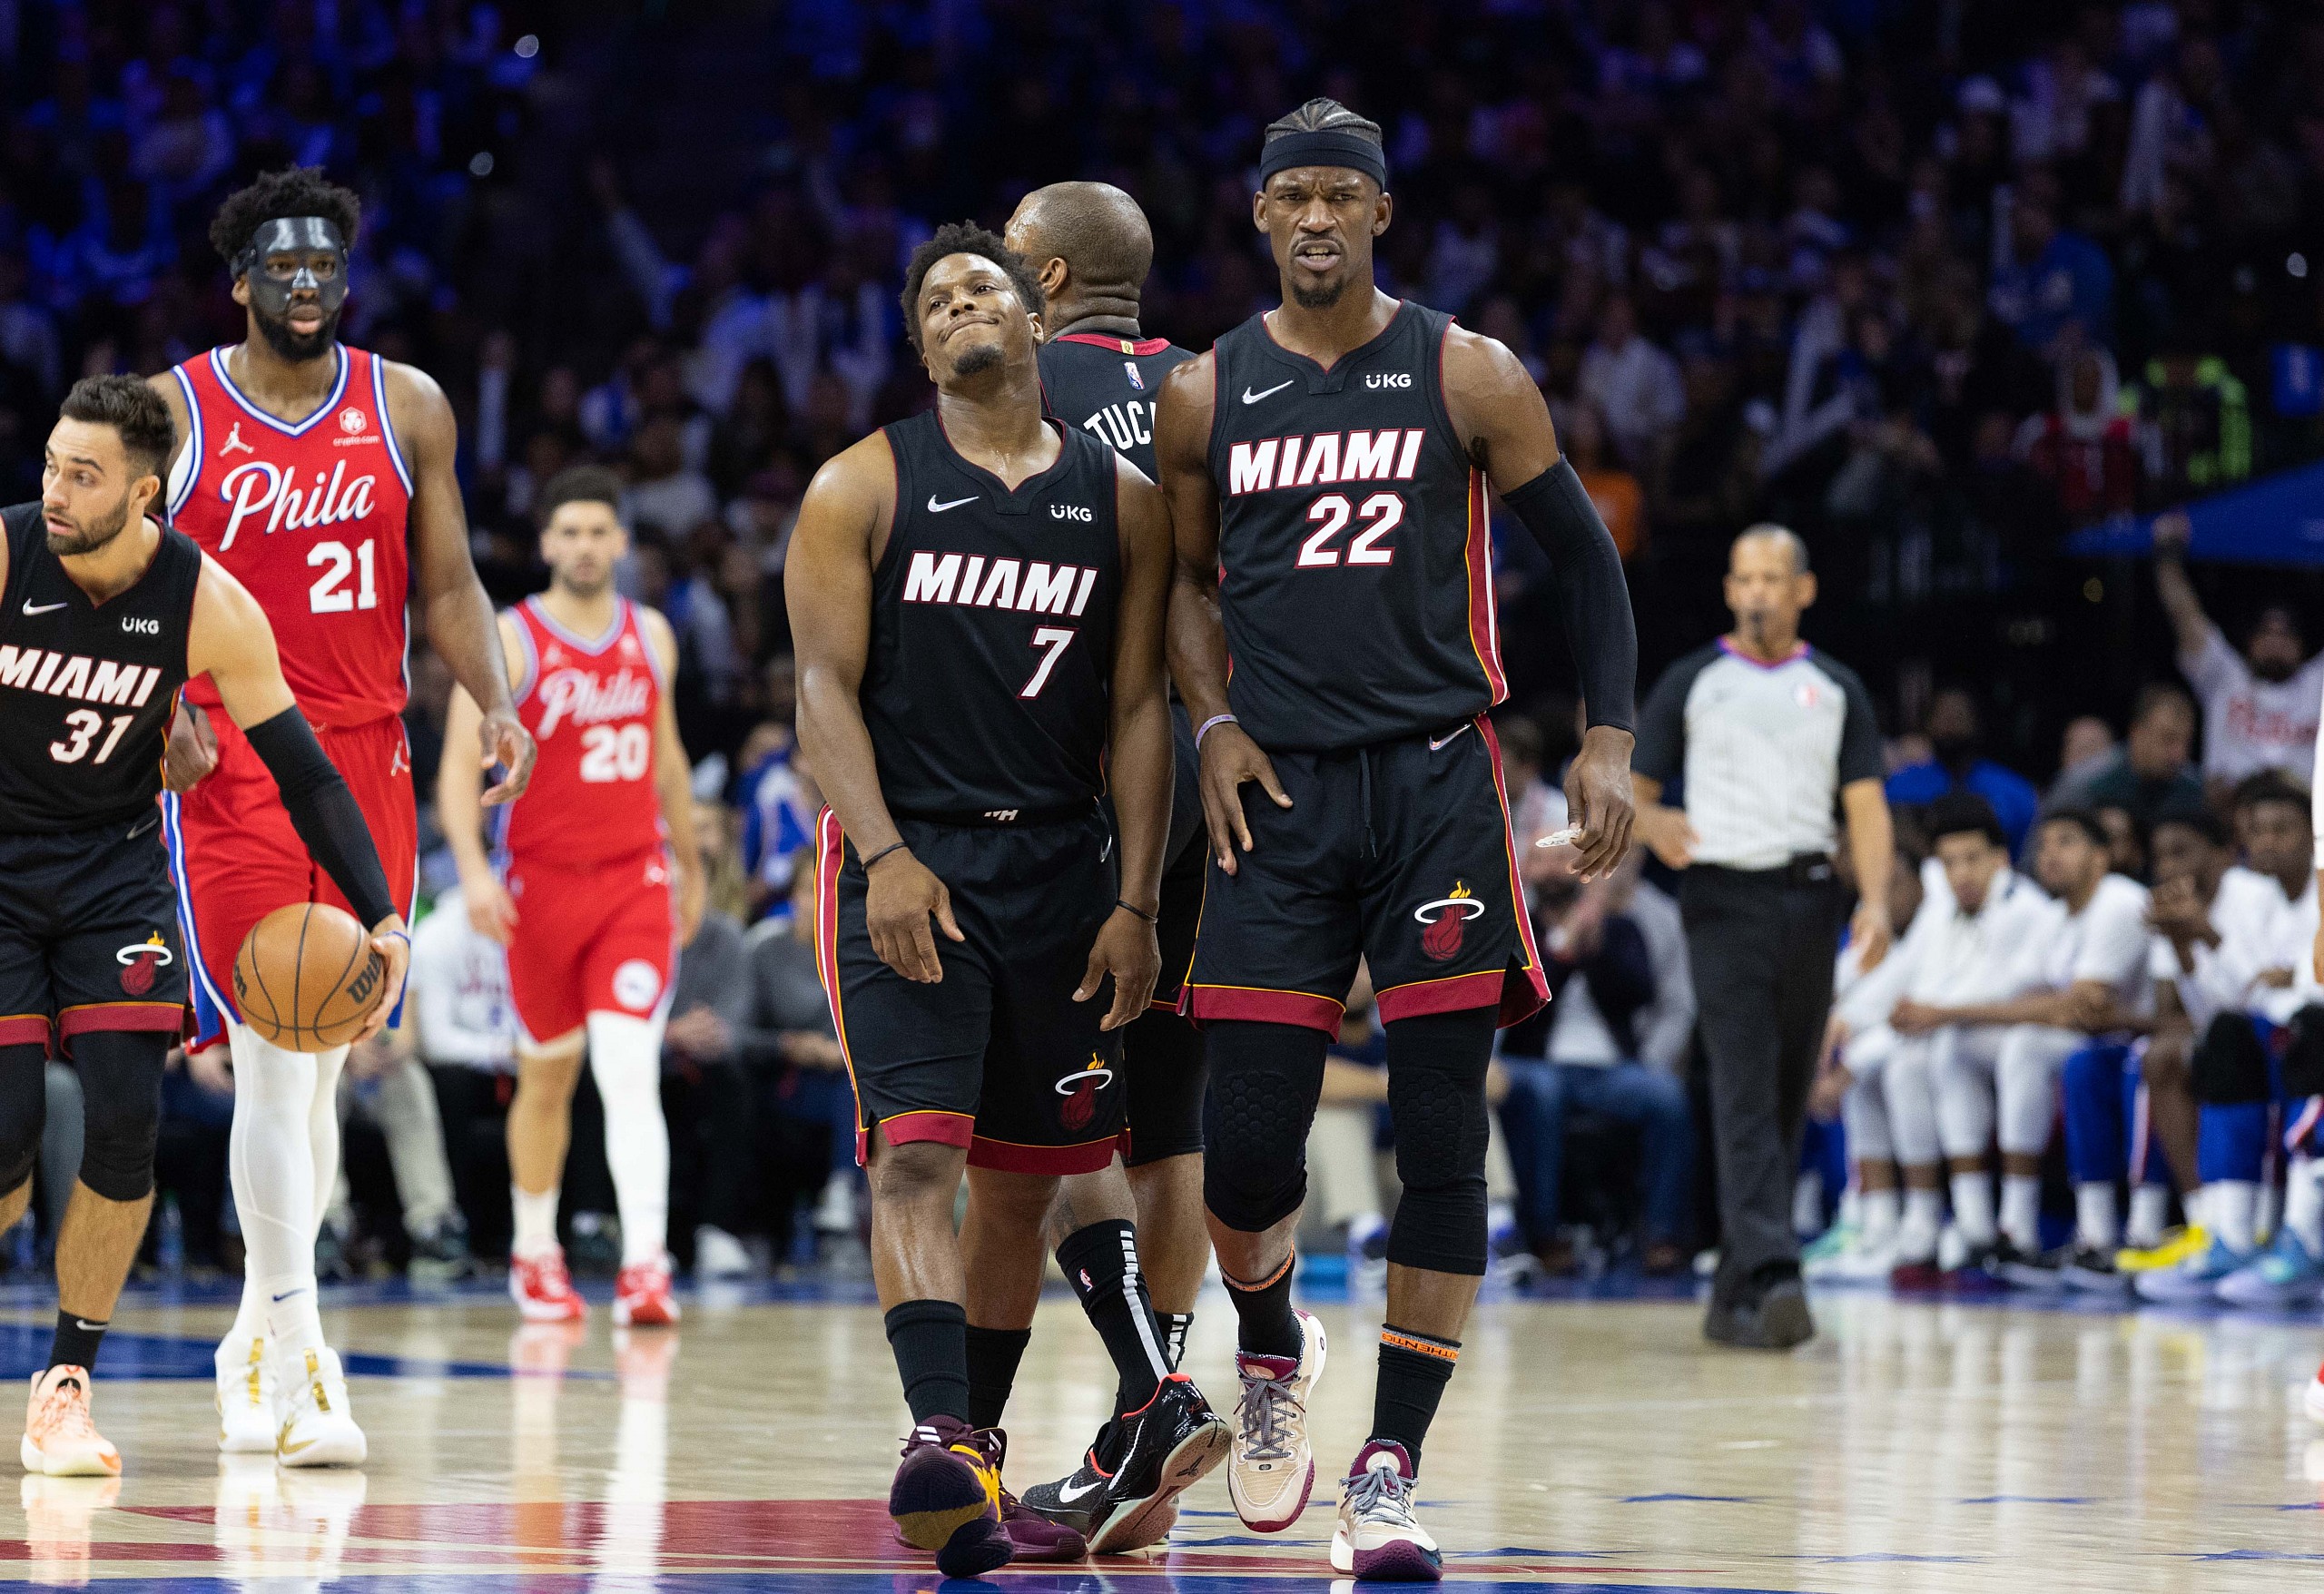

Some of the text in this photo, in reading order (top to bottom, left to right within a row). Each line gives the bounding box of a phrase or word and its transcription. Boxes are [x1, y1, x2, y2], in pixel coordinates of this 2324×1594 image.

[1229, 428, 1426, 497] MIAMI
[218, 458, 376, 553] Phila
[1294, 491, 1407, 569] 22
[307, 538, 378, 614] 21
[902, 550, 1099, 617] MIAMI
[122, 616, 160, 635] UKG
[0, 644, 162, 708] MIAMI
[1017, 625, 1079, 699] 7
[49, 708, 135, 765] 31
[580, 723, 651, 782] 20
